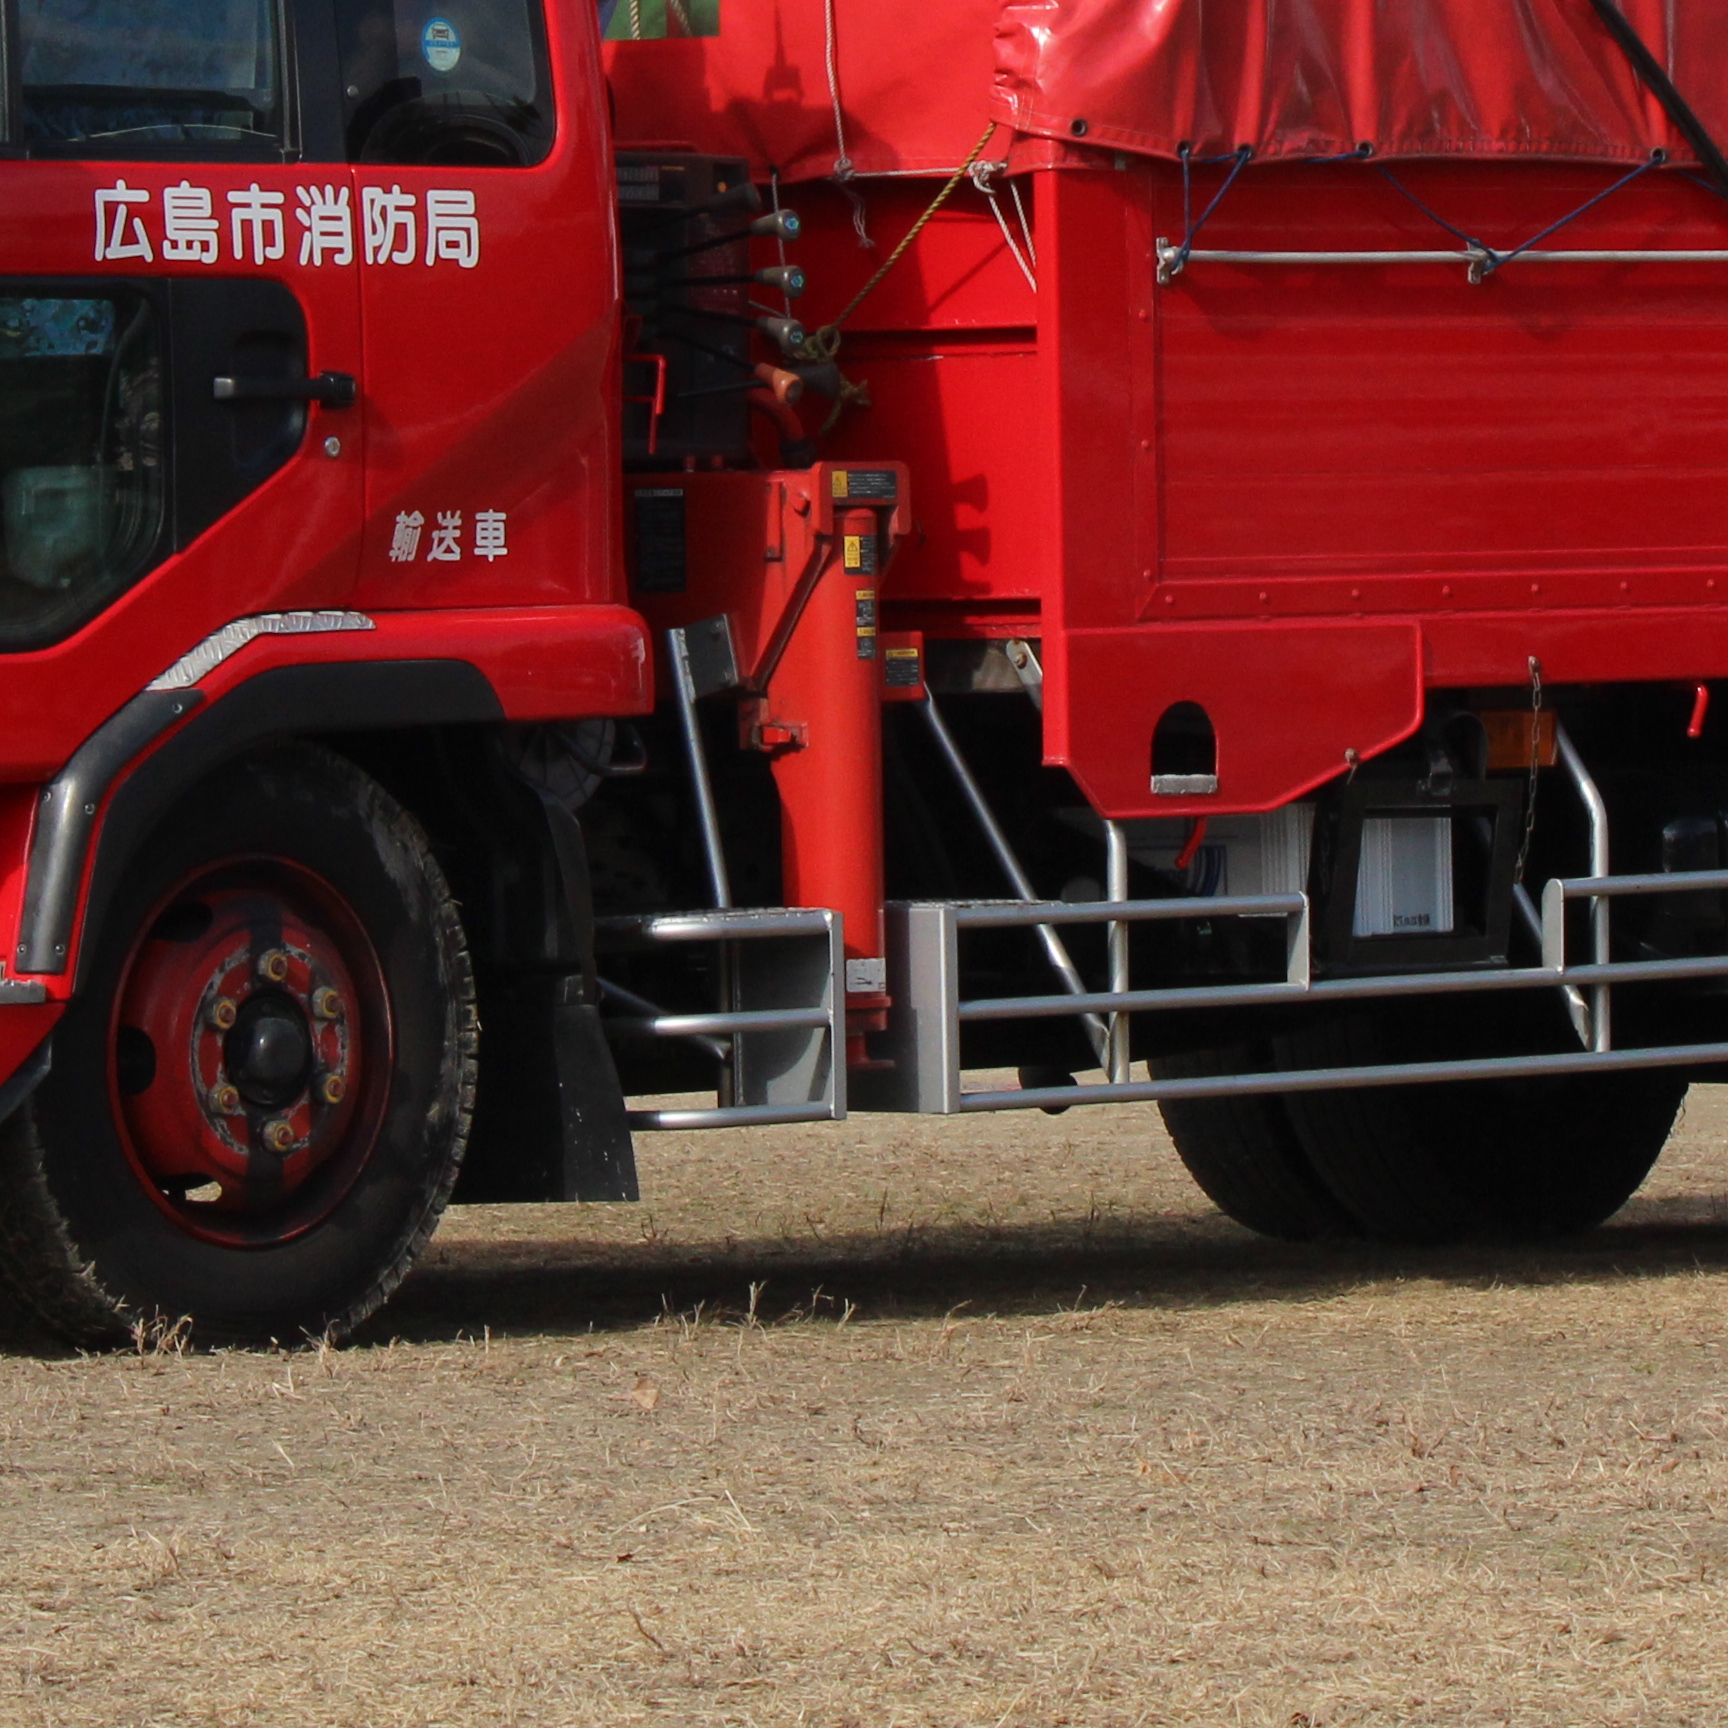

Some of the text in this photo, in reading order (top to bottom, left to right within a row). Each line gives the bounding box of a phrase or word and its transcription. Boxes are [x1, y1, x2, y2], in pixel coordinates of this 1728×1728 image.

[93, 179, 480, 269] 広島市消防局
[389, 509, 508, 563] 輸送車
